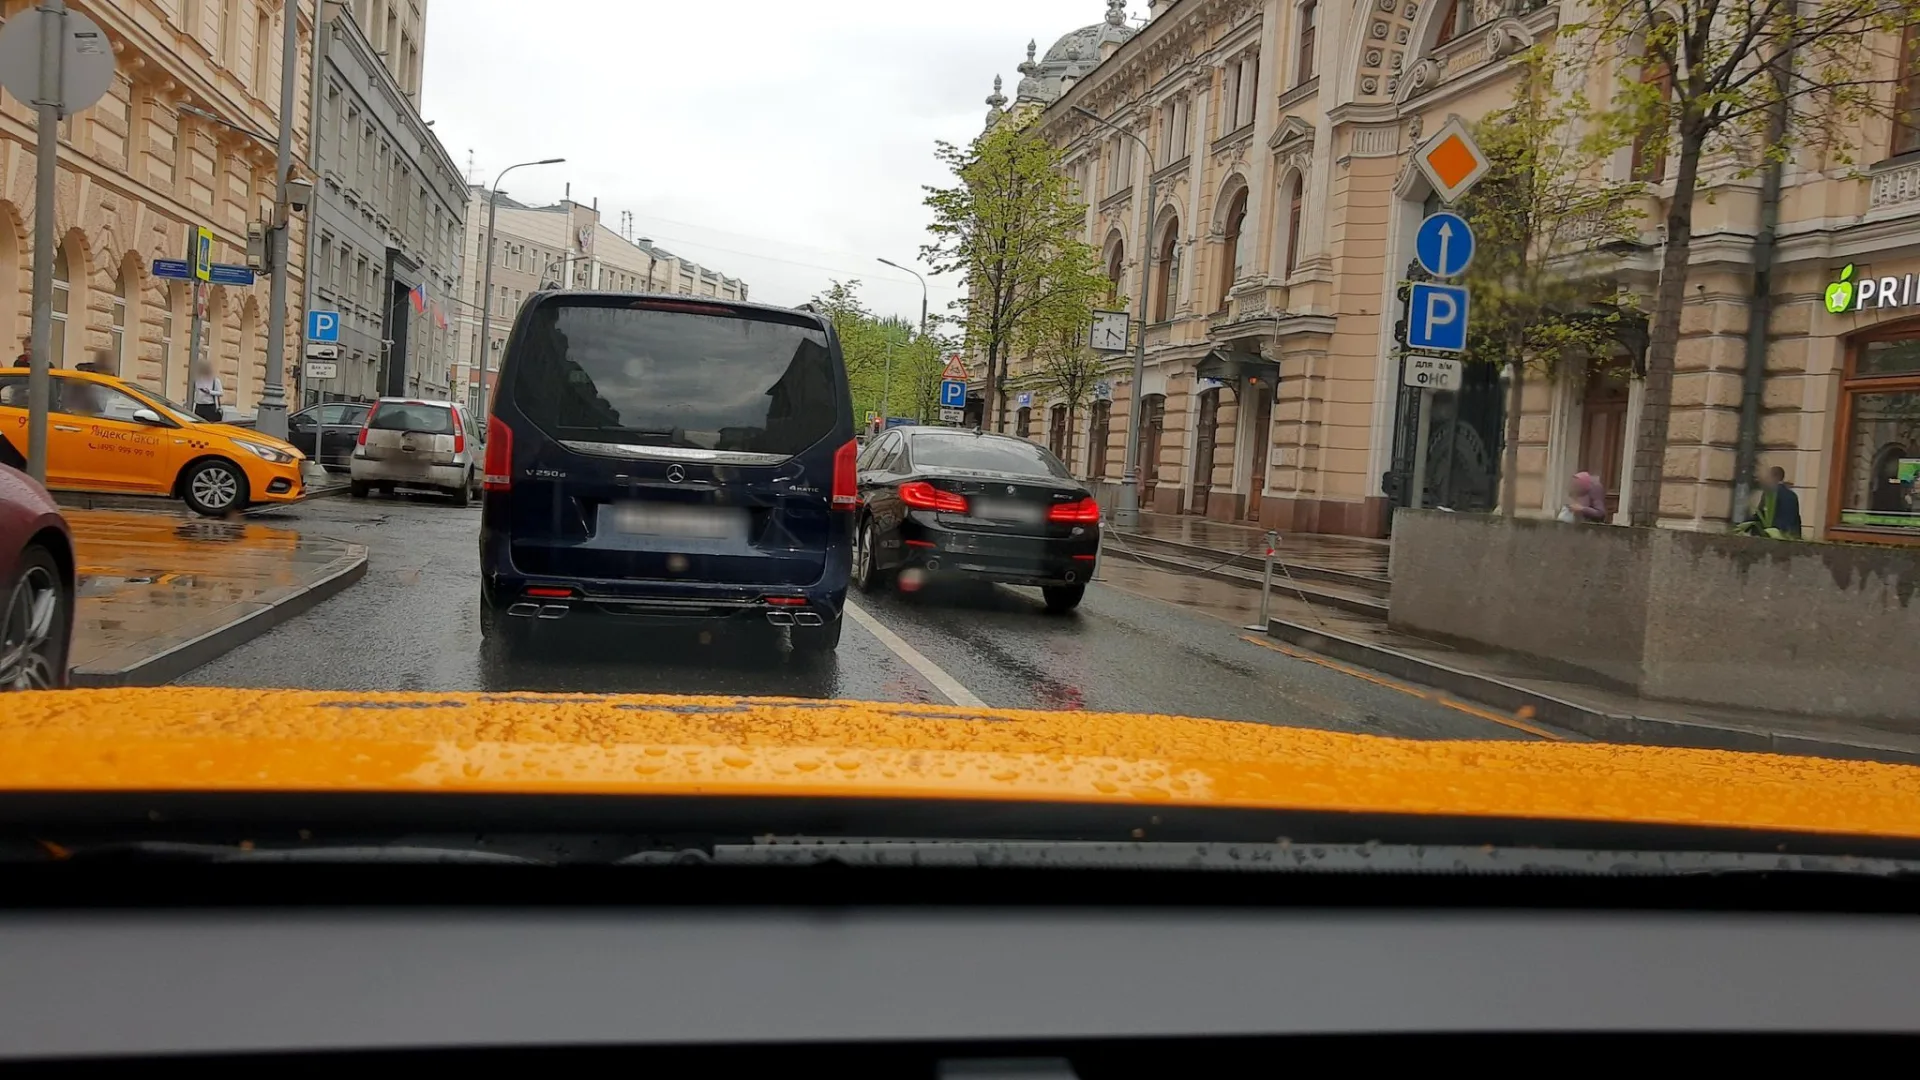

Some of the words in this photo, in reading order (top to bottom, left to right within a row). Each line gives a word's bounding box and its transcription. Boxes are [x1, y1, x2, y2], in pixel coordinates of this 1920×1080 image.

[1856, 273, 1920, 310] PRI
[316, 314, 333, 337] P
[1424, 292, 1457, 341] P
[1417, 372, 1449, 387] ФНС
[947, 383, 962, 403] P
[90, 424, 127, 441] Яндекс
[130, 431, 160, 446] Такси
